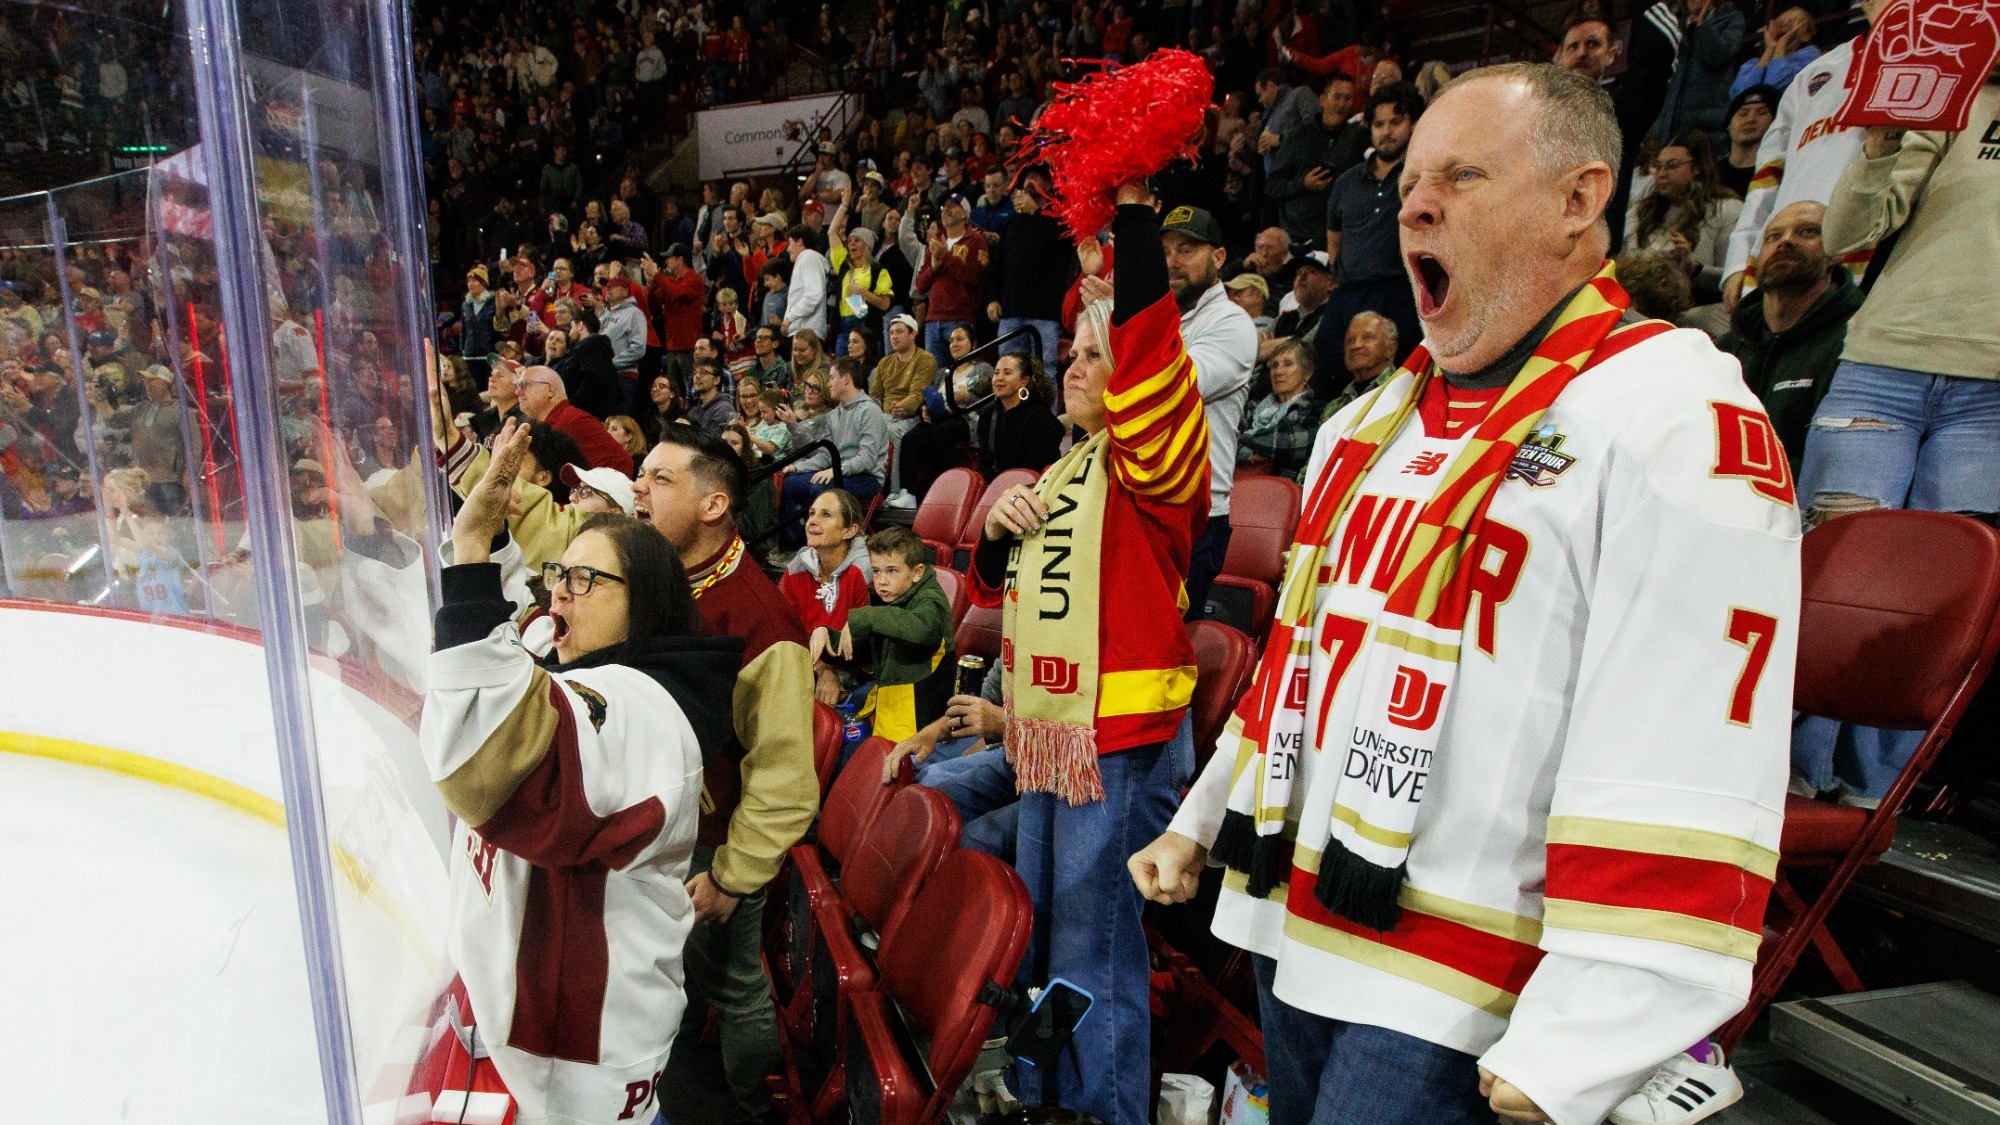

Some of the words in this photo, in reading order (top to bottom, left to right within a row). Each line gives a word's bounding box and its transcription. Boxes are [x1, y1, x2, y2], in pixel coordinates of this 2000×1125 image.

[1515, 448, 1536, 462] ZEN
[1534, 452, 1567, 470] FOUR
[1031, 654, 1080, 695] DU
[1315, 611, 1375, 757] 7
[1724, 605, 1779, 729] 7
